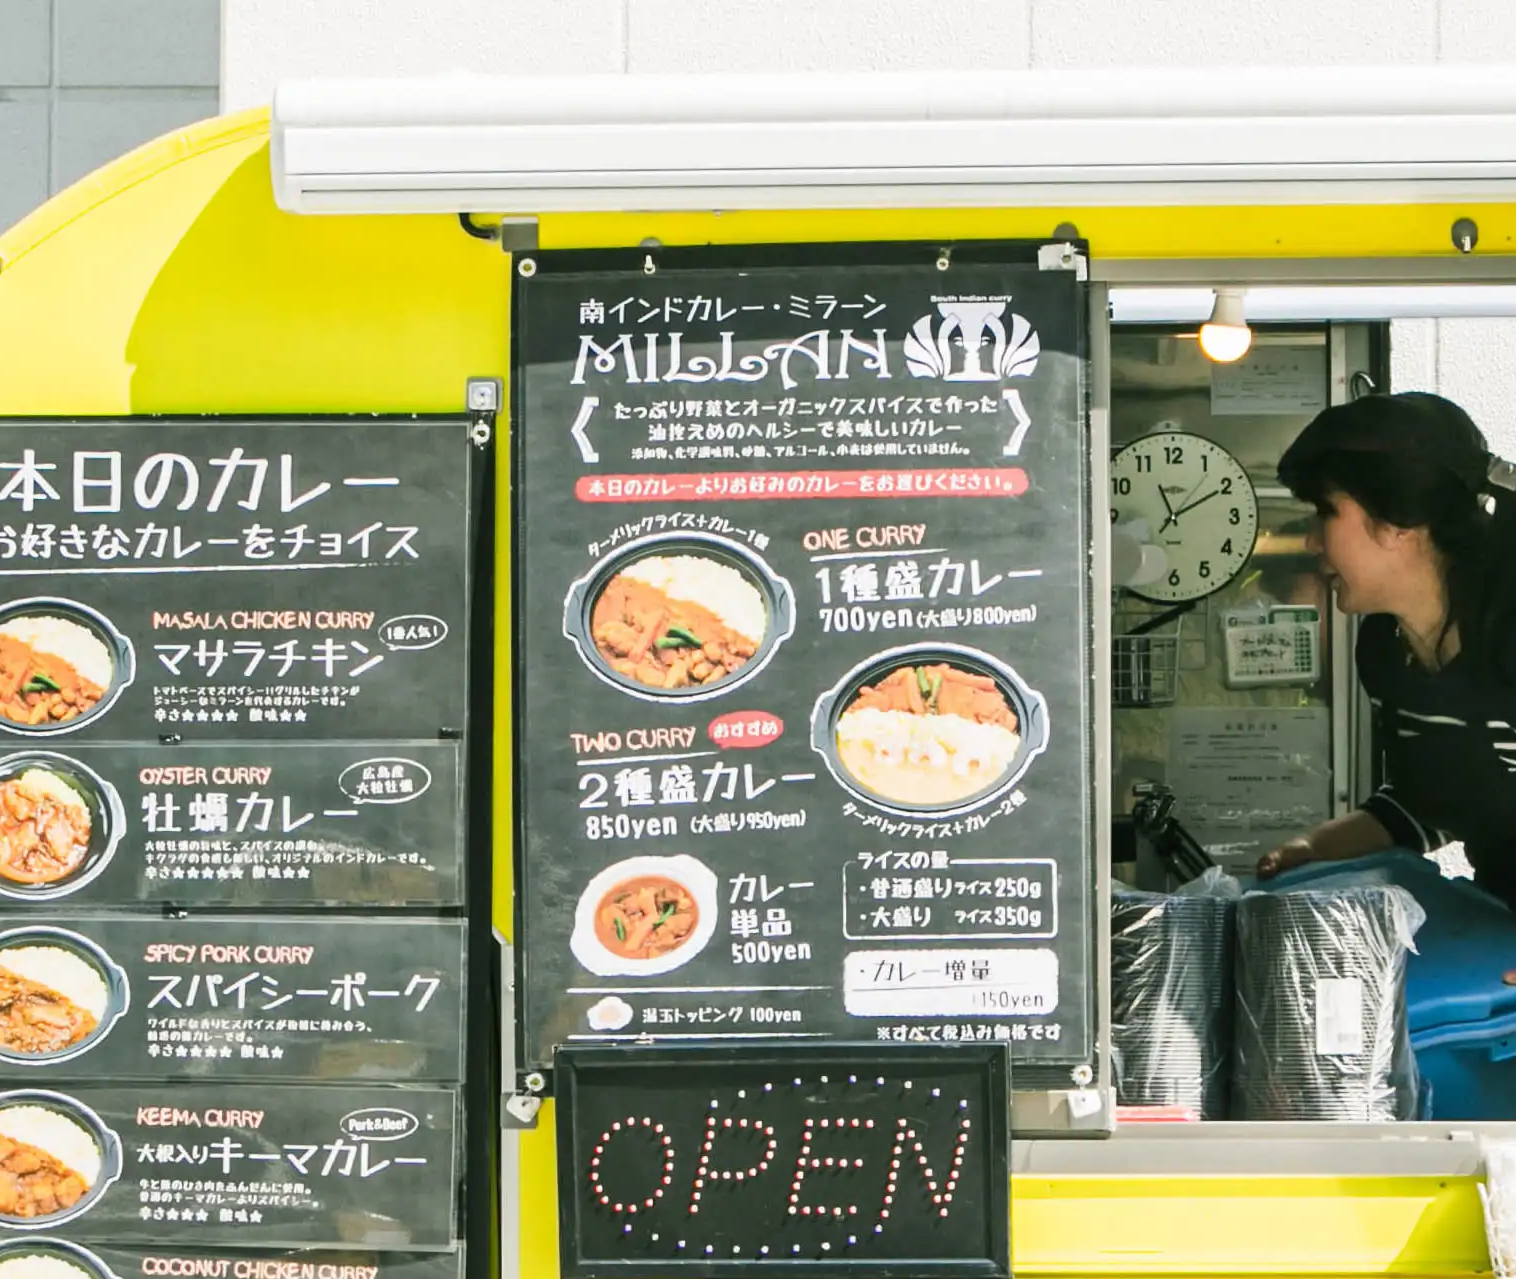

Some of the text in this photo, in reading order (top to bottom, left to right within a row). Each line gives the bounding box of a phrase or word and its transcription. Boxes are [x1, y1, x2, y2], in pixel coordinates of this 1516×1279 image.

[578, 294, 887, 325] 南インドカレー・ミラーン
[570, 328, 892, 390] MILLAN
[613, 395, 999, 421] たっぷり野菜とオーガニックスパイスで作った
[647, 421, 962, 443] 油控えめのヘルシーで美味しいカレー
[1134, 455, 1152, 473] 11
[1163, 447, 1184, 465] 12
[1200, 455, 1208, 472] 1
[587, 473, 1014, 496] 本日のカレーよりお好みのカレーをお選びください。
[1110, 477, 1131, 495] 10
[1220, 477, 1233, 495] 2
[1228, 507, 1241, 525] 3
[803, 523, 927, 552] ONE CURRY
[1220, 538, 1232, 556] 4
[814, 556, 1044, 604] 1種盛カレー
[1168, 568, 1181, 586] 6
[1198, 560, 1211, 578] 5
[152, 611, 375, 630] MASALA CHICKEN CURRY
[819, 606, 914, 633] 700yen
[153, 637, 384, 678] マサラチキン
[712, 719, 779, 739] おすすめ
[570, 726, 696, 755] TWO CURRY
[139, 767, 272, 786] OYSTER CURRY
[578, 761, 816, 809] 2種盛カレー
[141, 791, 359, 833] 牡蠣カレー
[585, 813, 678, 841] 850yen
[857, 850, 950, 869] ライスの量
[729, 872, 815, 904] カレー
[730, 908, 792, 938] 単品
[144, 944, 314, 965] SPICY PORK CURRY
[731, 940, 812, 964] 500yen
[147, 971, 441, 1013] スパイシーポーク
[642, 1006, 802, 1024] 温玉トッピング 100yen
[136, 1107, 264, 1129] KEEMA CURRY
[136, 1136, 427, 1177] 大根入りキーマカレー
[590, 1116, 972, 1218] OPEN
[142, 1257, 231, 1278] COCONUT
